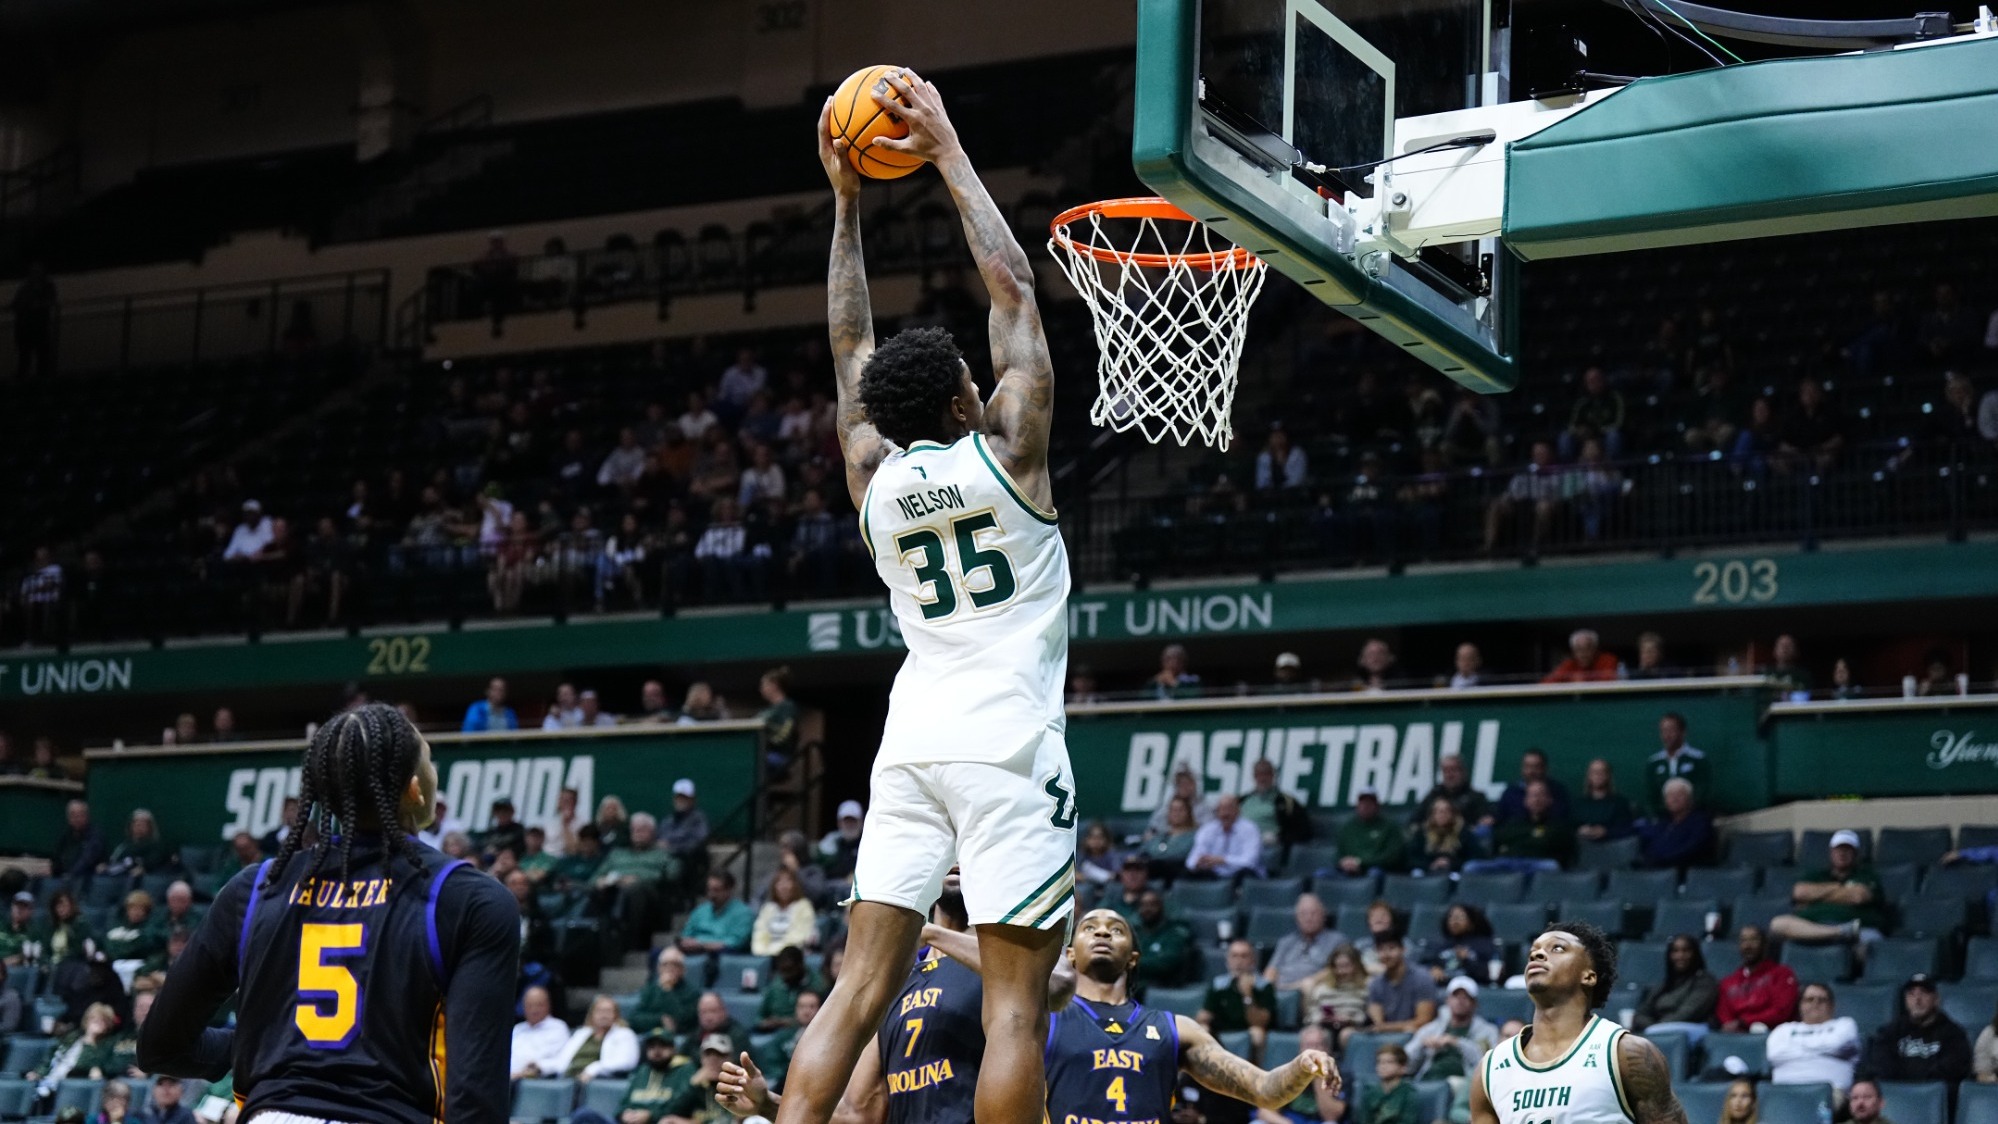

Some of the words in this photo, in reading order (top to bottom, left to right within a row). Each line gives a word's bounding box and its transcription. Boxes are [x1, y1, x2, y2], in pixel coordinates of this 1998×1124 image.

[896, 484, 966, 520] NELSON
[892, 505, 1020, 624] 35
[1693, 559, 1779, 603] 203
[857, 608, 904, 648] US
[1124, 593, 1274, 636] UNION
[367, 635, 431, 675] 202
[20, 658, 132, 695] UNION
[295, 923, 369, 1050] 5
[900, 987, 942, 1018] EAST
[904, 1017, 924, 1058] 7
[887, 1058, 954, 1095] ROLINA
[1093, 1048, 1145, 1074] EAST
[1105, 1075, 1129, 1113] 4
[1513, 1085, 1572, 1112] SOUTH
